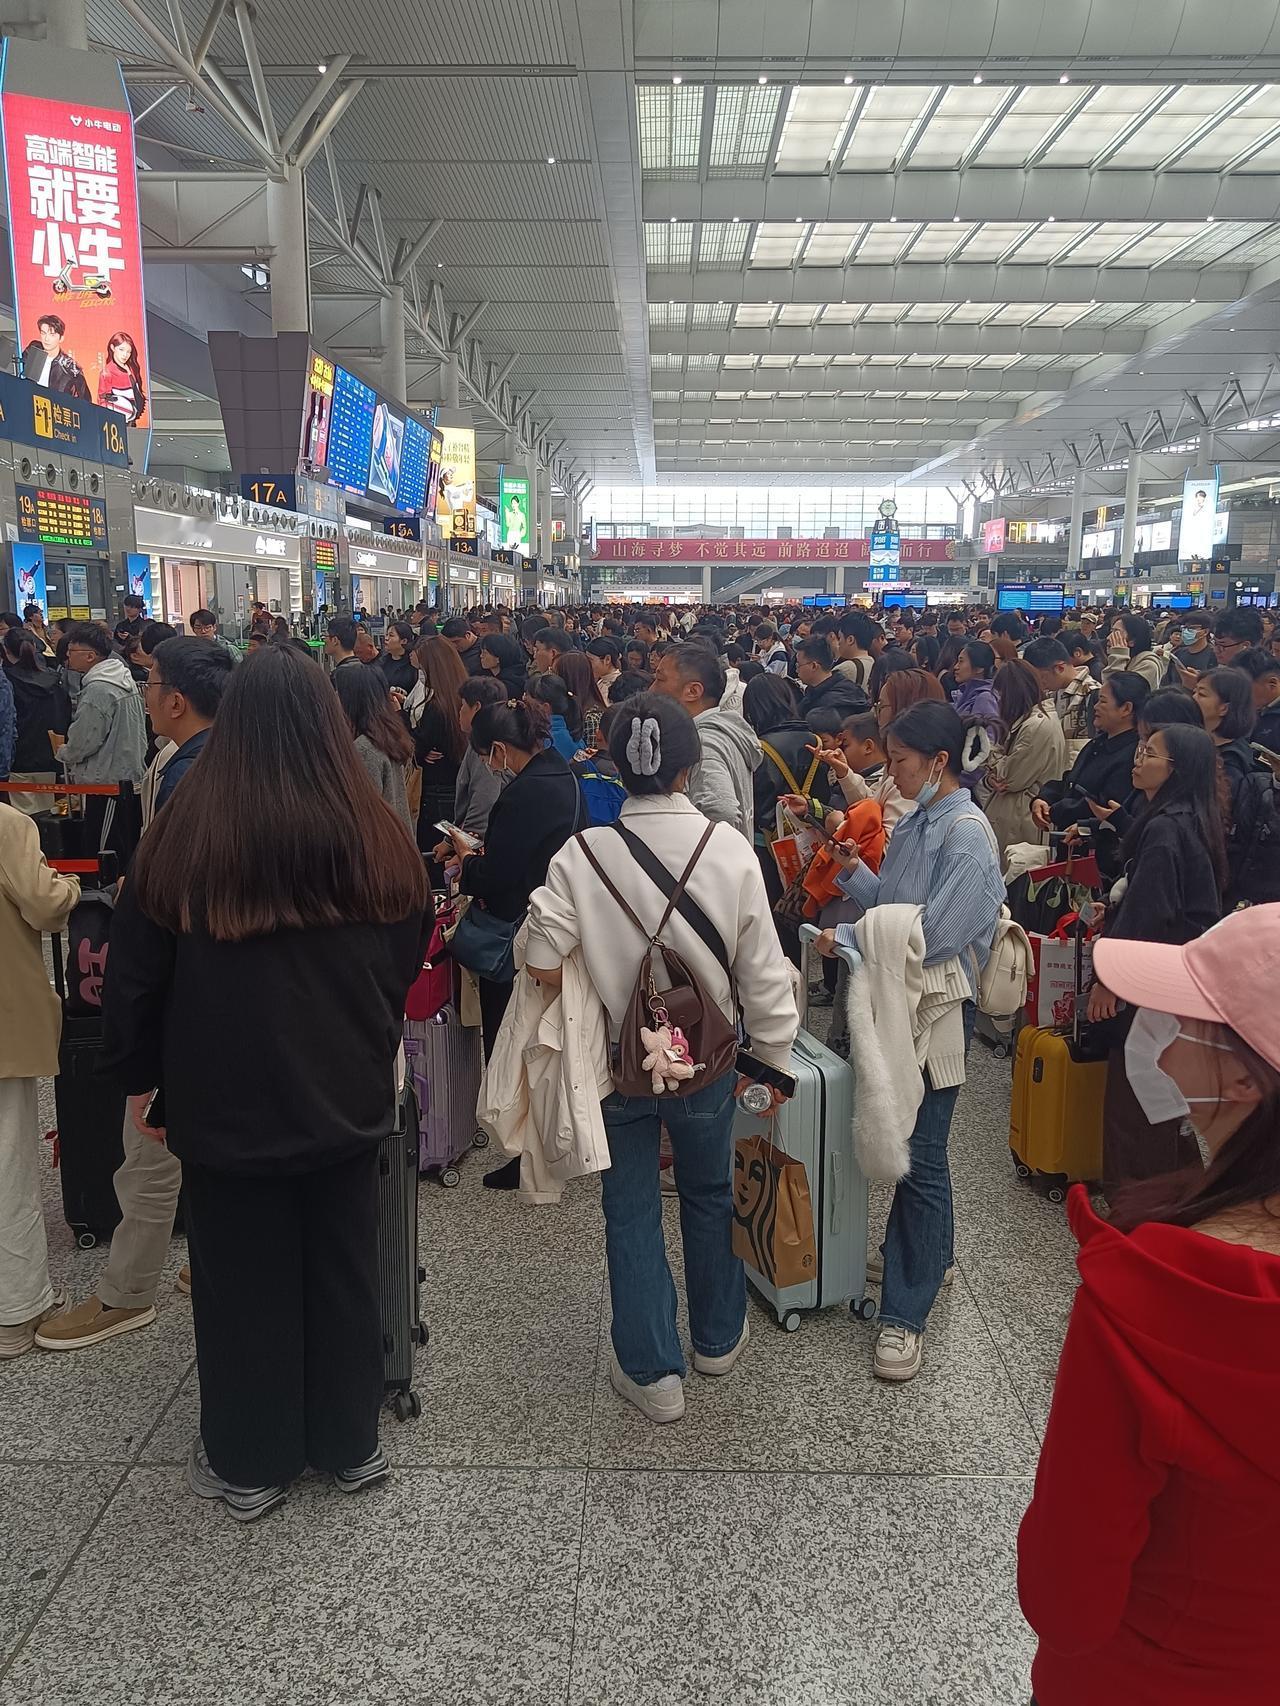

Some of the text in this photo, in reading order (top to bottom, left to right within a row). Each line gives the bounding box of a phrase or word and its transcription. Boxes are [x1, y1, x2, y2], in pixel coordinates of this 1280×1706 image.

[84, 118, 122, 133] 小牛电动
[25, 134, 118, 174] 高端智能
[27, 165, 121, 230] 就要
[31, 222, 126, 282] 小牛
[53, 403, 80, 430] 检票口
[54, 428, 71, 441] Check
[103, 421, 125, 455] 18A
[250, 482, 287, 503] 17A
[19, 495, 36, 515] 19A
[92, 507, 105, 525] 18A
[389, 522, 414, 538] 15A
[454, 541, 473, 553] 13A
[613, 541, 684, 558] 山海寻梦
[695, 541, 767, 558] 不觉其远
[777, 541, 849, 558] 前路迢迢
[495, 553, 509, 563] 11A
[523, 561, 532, 569] 9A
